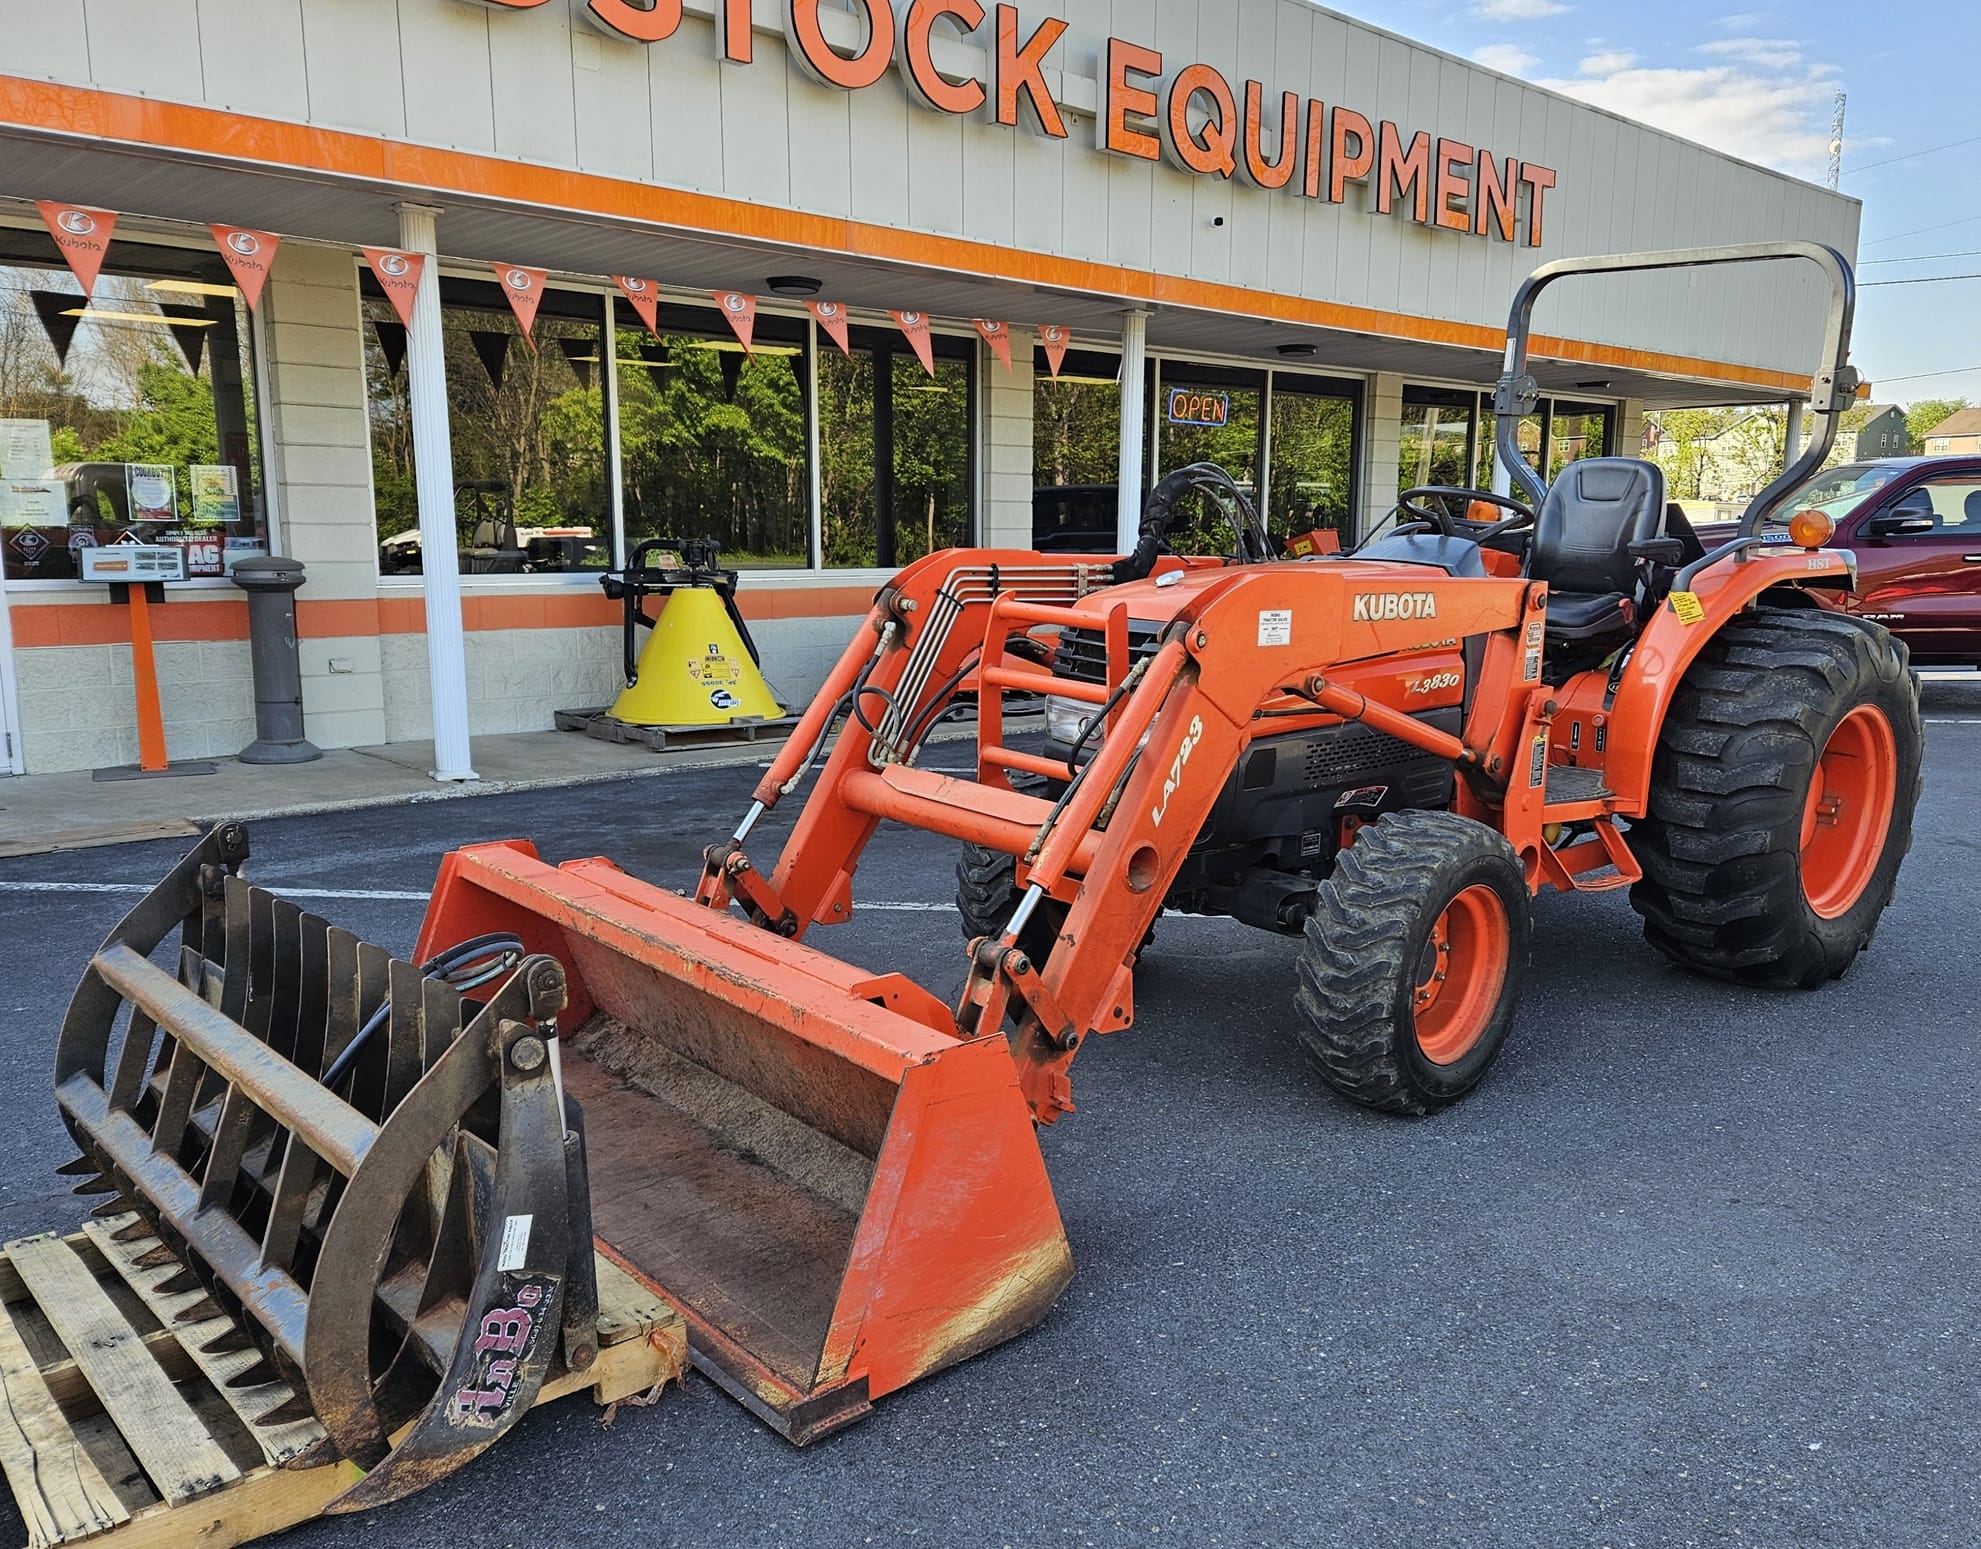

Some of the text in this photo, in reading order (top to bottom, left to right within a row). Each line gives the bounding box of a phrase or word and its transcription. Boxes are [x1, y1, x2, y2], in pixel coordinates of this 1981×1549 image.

[1105, 36, 1557, 248] EQUIPMENT
[55, 234, 101, 251] Kubota
[224, 253, 264, 272] Kubota
[1173, 394, 1225, 421] OPEN
[1807, 558, 1831, 570] HST
[1353, 592, 1437, 622] KUBOTA
[1410, 672, 1460, 694] L3830
[1151, 713, 1203, 828] LA723
